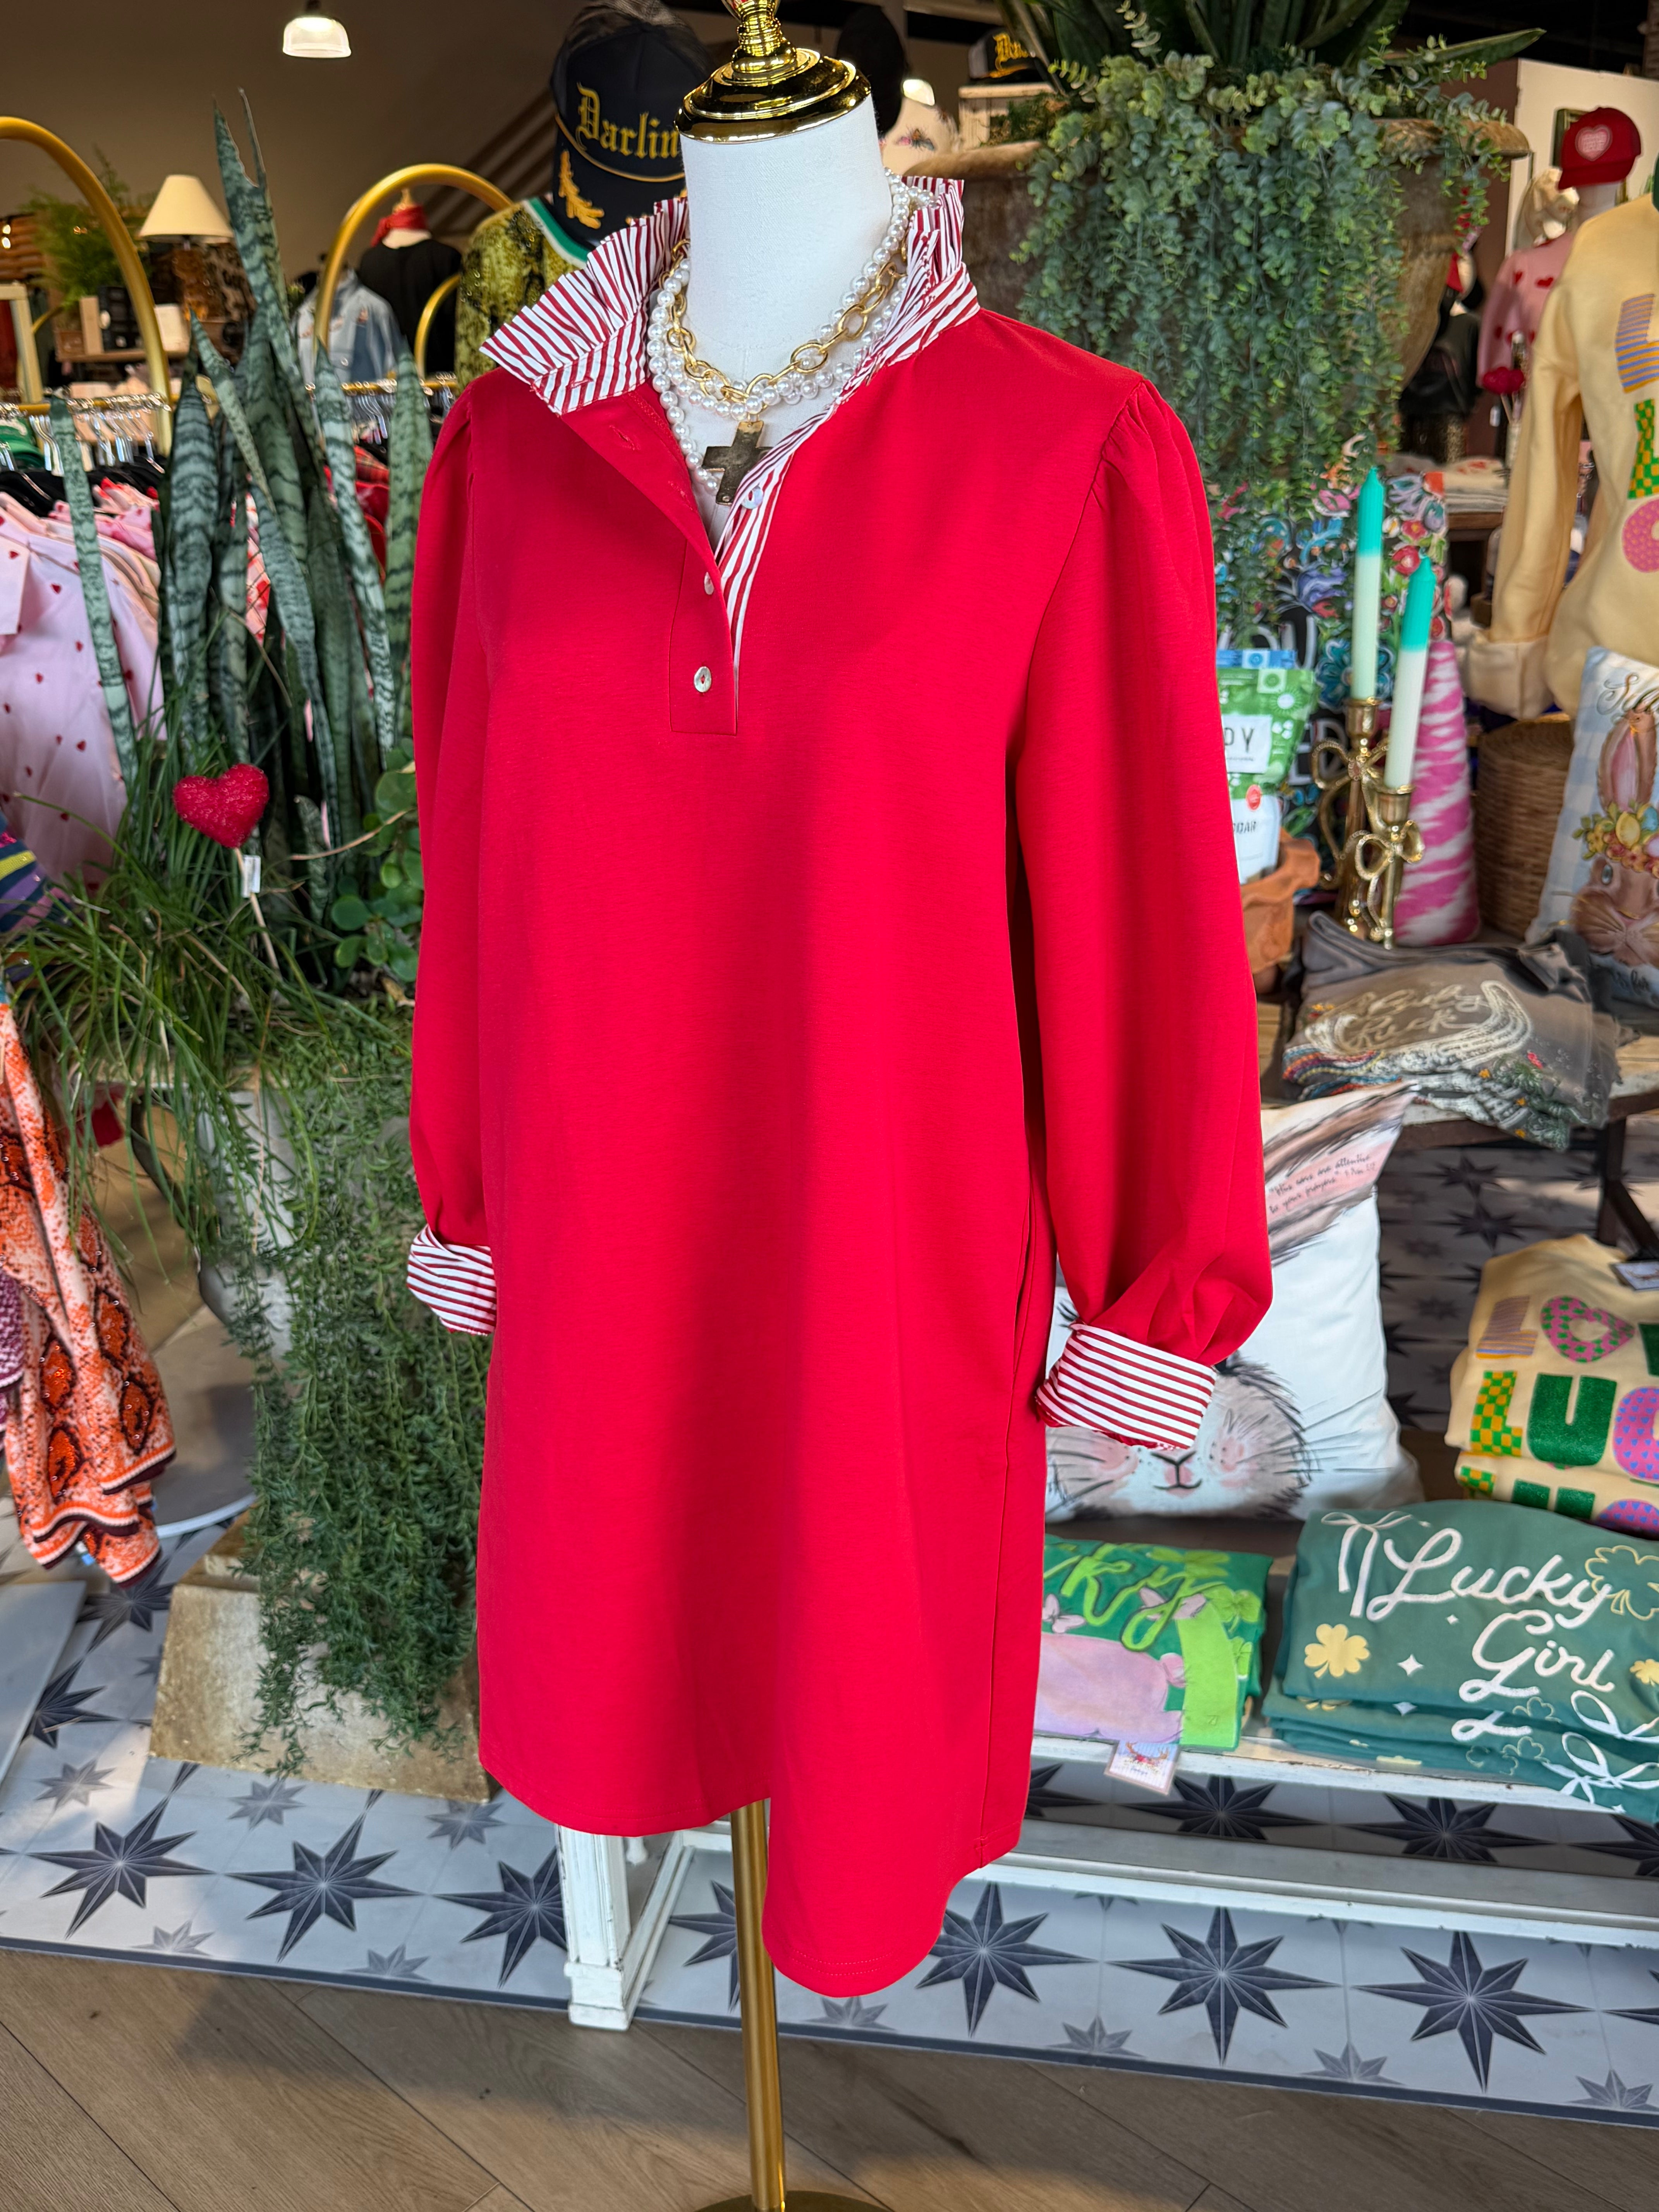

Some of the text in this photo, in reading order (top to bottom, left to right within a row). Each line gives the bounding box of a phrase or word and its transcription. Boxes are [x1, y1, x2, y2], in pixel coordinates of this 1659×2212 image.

[575, 81, 678, 159] Darlin
[1044, 1542, 1226, 1652] ky
[1366, 1528, 1613, 1629] Lucky
[1459, 1609, 1615, 1703] Girl
